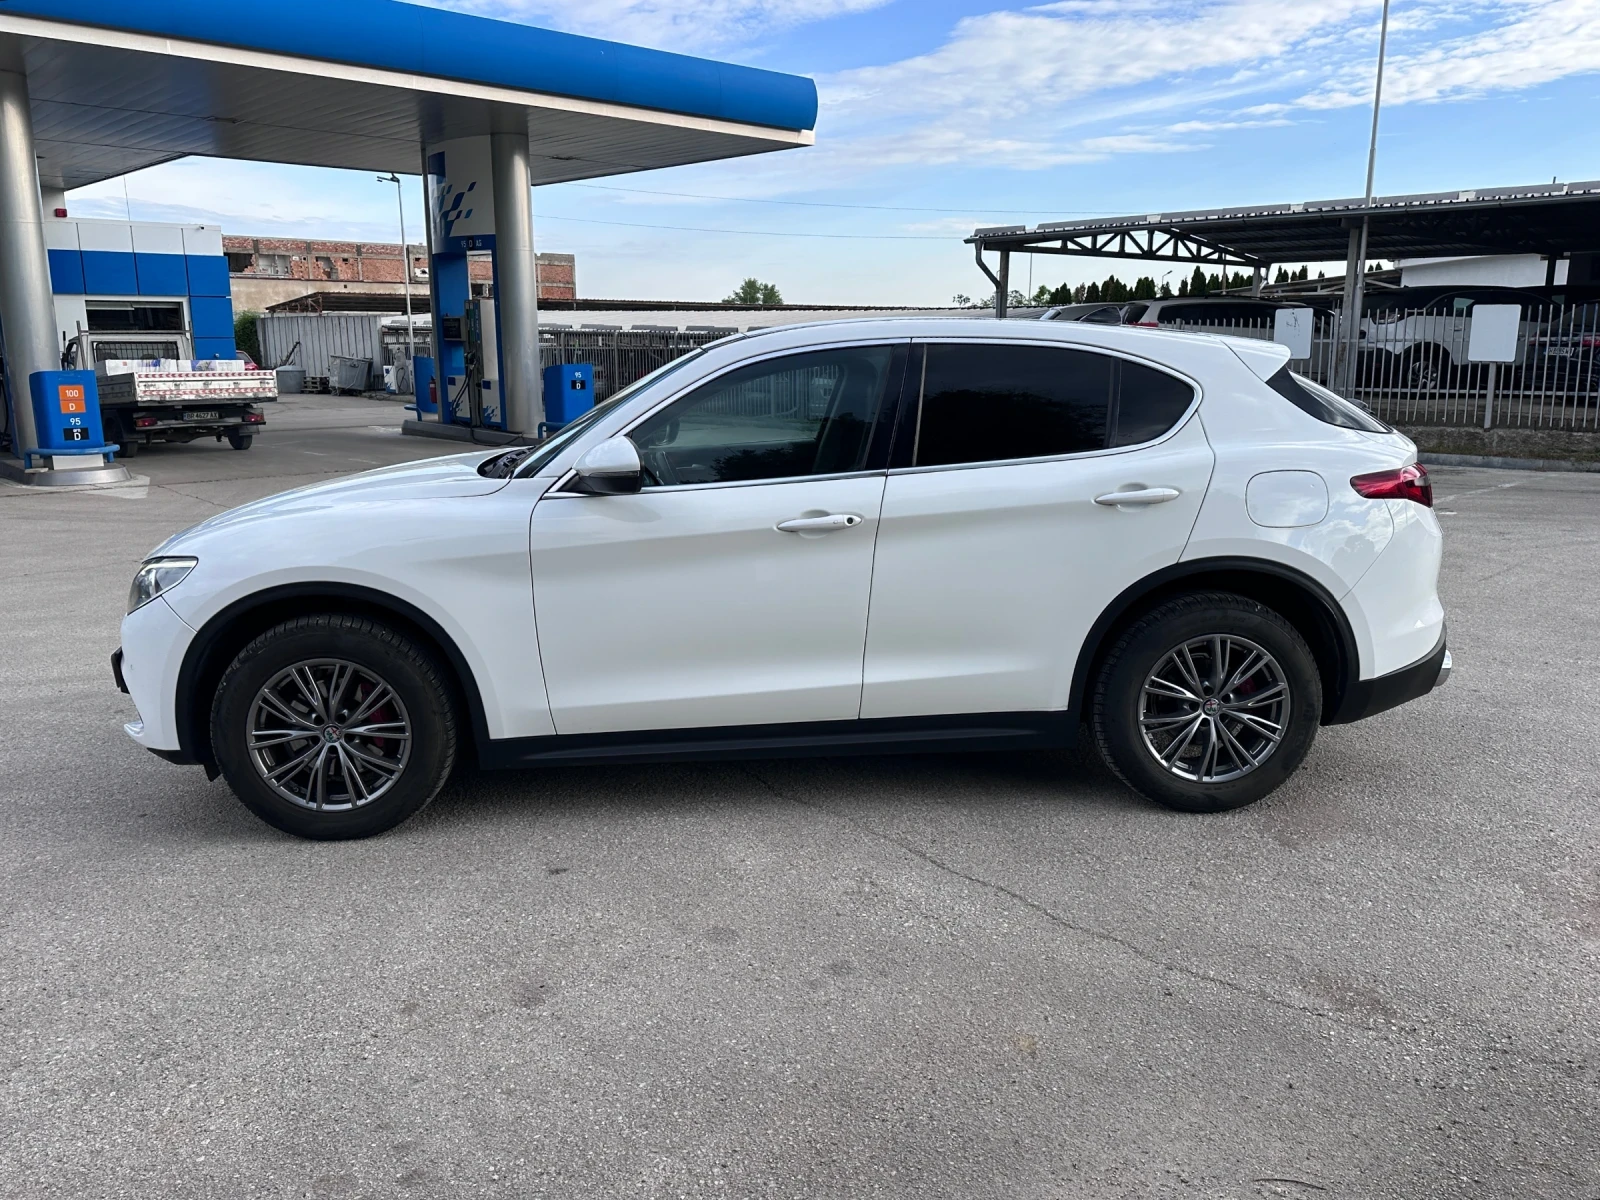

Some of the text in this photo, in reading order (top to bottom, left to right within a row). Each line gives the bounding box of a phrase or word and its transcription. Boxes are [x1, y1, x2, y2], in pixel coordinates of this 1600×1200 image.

[65, 389, 79, 397] 100
[70, 417, 81, 425] 95
[73, 432, 81, 441] D
